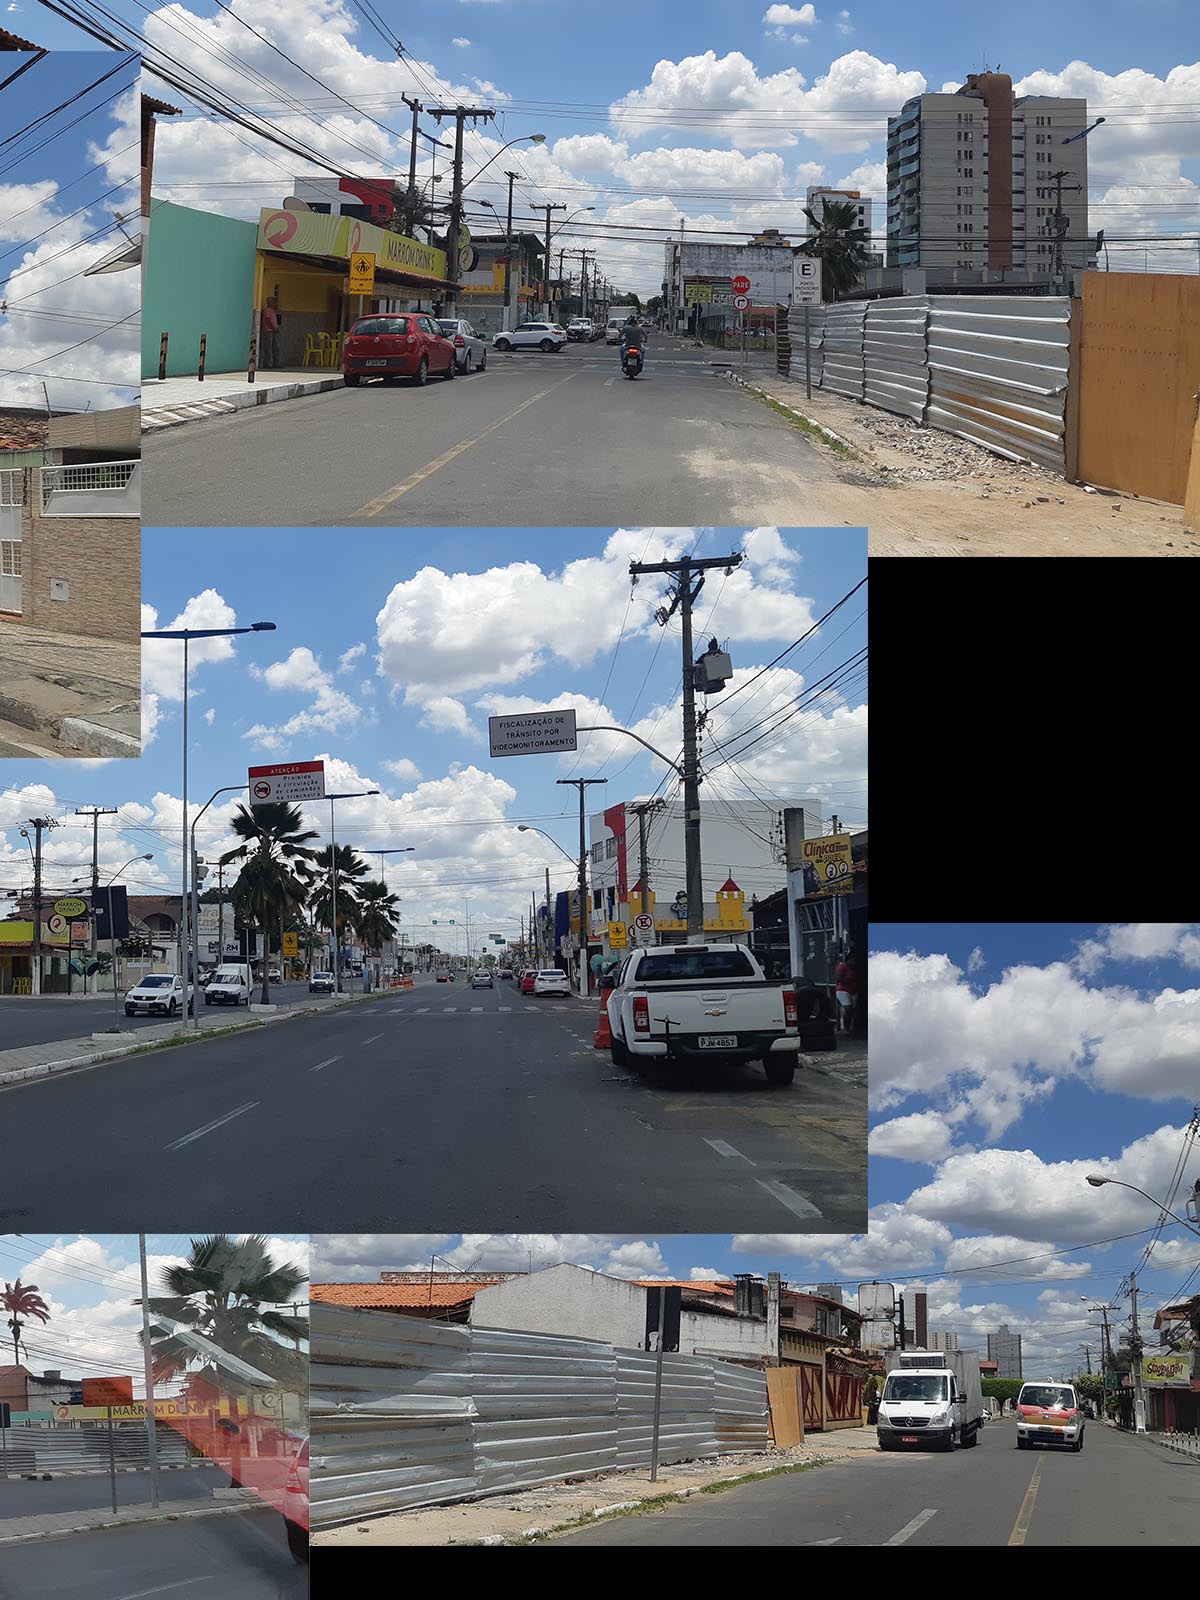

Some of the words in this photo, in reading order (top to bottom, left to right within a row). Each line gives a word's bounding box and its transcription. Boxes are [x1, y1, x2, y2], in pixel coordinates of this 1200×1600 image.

[387, 238, 415, 267] MARROM
[801, 263, 812, 276] E
[732, 281, 750, 289] PARE
[499, 716, 553, 729] FISCALIZAÇÃO
[555, 716, 566, 724] DE
[505, 729, 542, 739] TRÂNSITO
[544, 728, 560, 736] POR
[492, 737, 575, 751] VIDEOMONITORAMENTO
[270, 766, 301, 775] ATENÇÃO
[112, 1405, 165, 1416] MARRM
